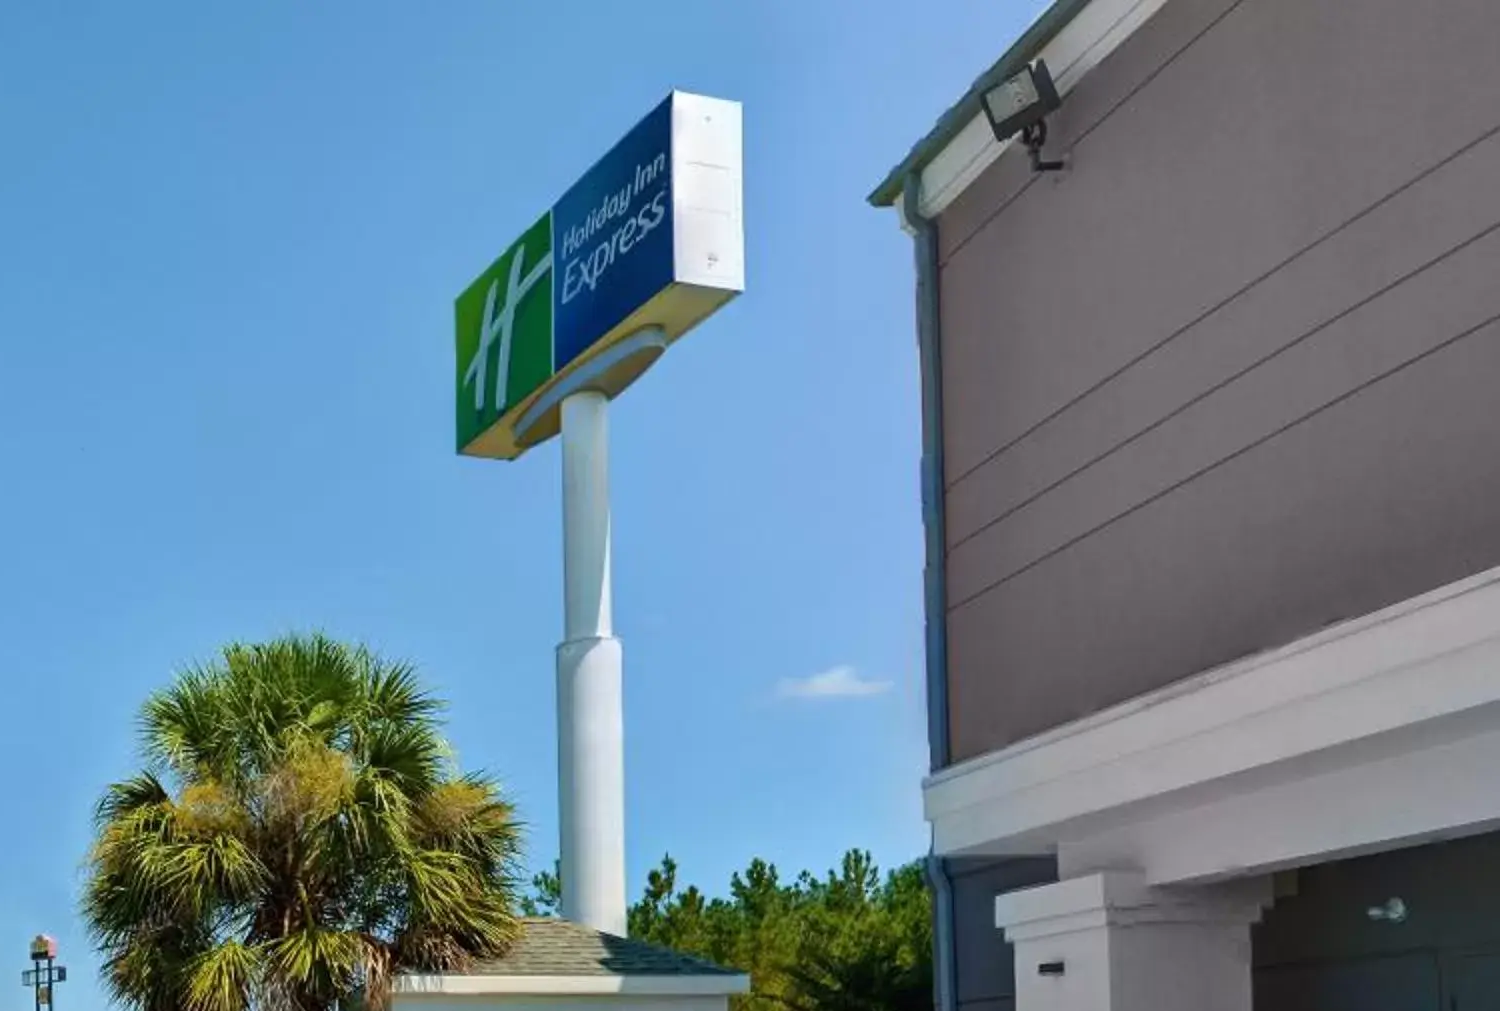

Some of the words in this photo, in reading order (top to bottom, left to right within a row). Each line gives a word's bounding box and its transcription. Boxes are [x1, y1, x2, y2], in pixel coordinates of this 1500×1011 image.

[561, 184, 631, 258] Holiday
[633, 152, 666, 196] Inn
[561, 190, 666, 304] Express
